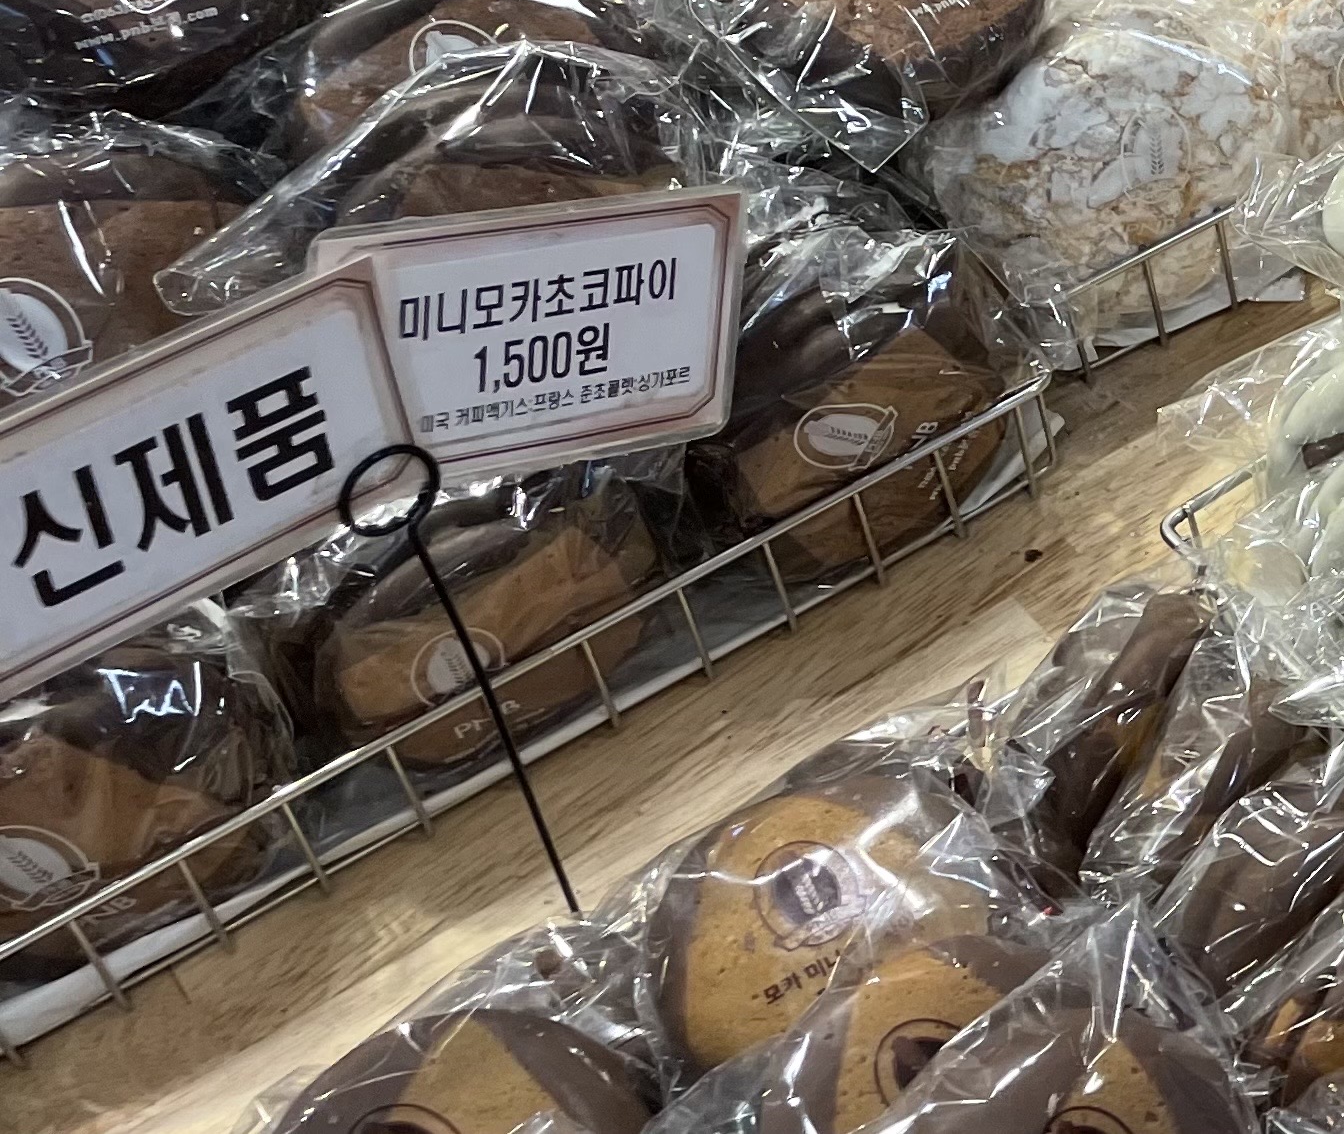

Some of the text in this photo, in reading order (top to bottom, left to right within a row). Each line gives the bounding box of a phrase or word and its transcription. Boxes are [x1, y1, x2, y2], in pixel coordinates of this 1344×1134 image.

[399, 257, 678, 342] 미니모카초코파이
[473, 323, 610, 394] 1,500원
[12, 364, 336, 609] 신제품
[763, 971, 803, 1005] 모카
